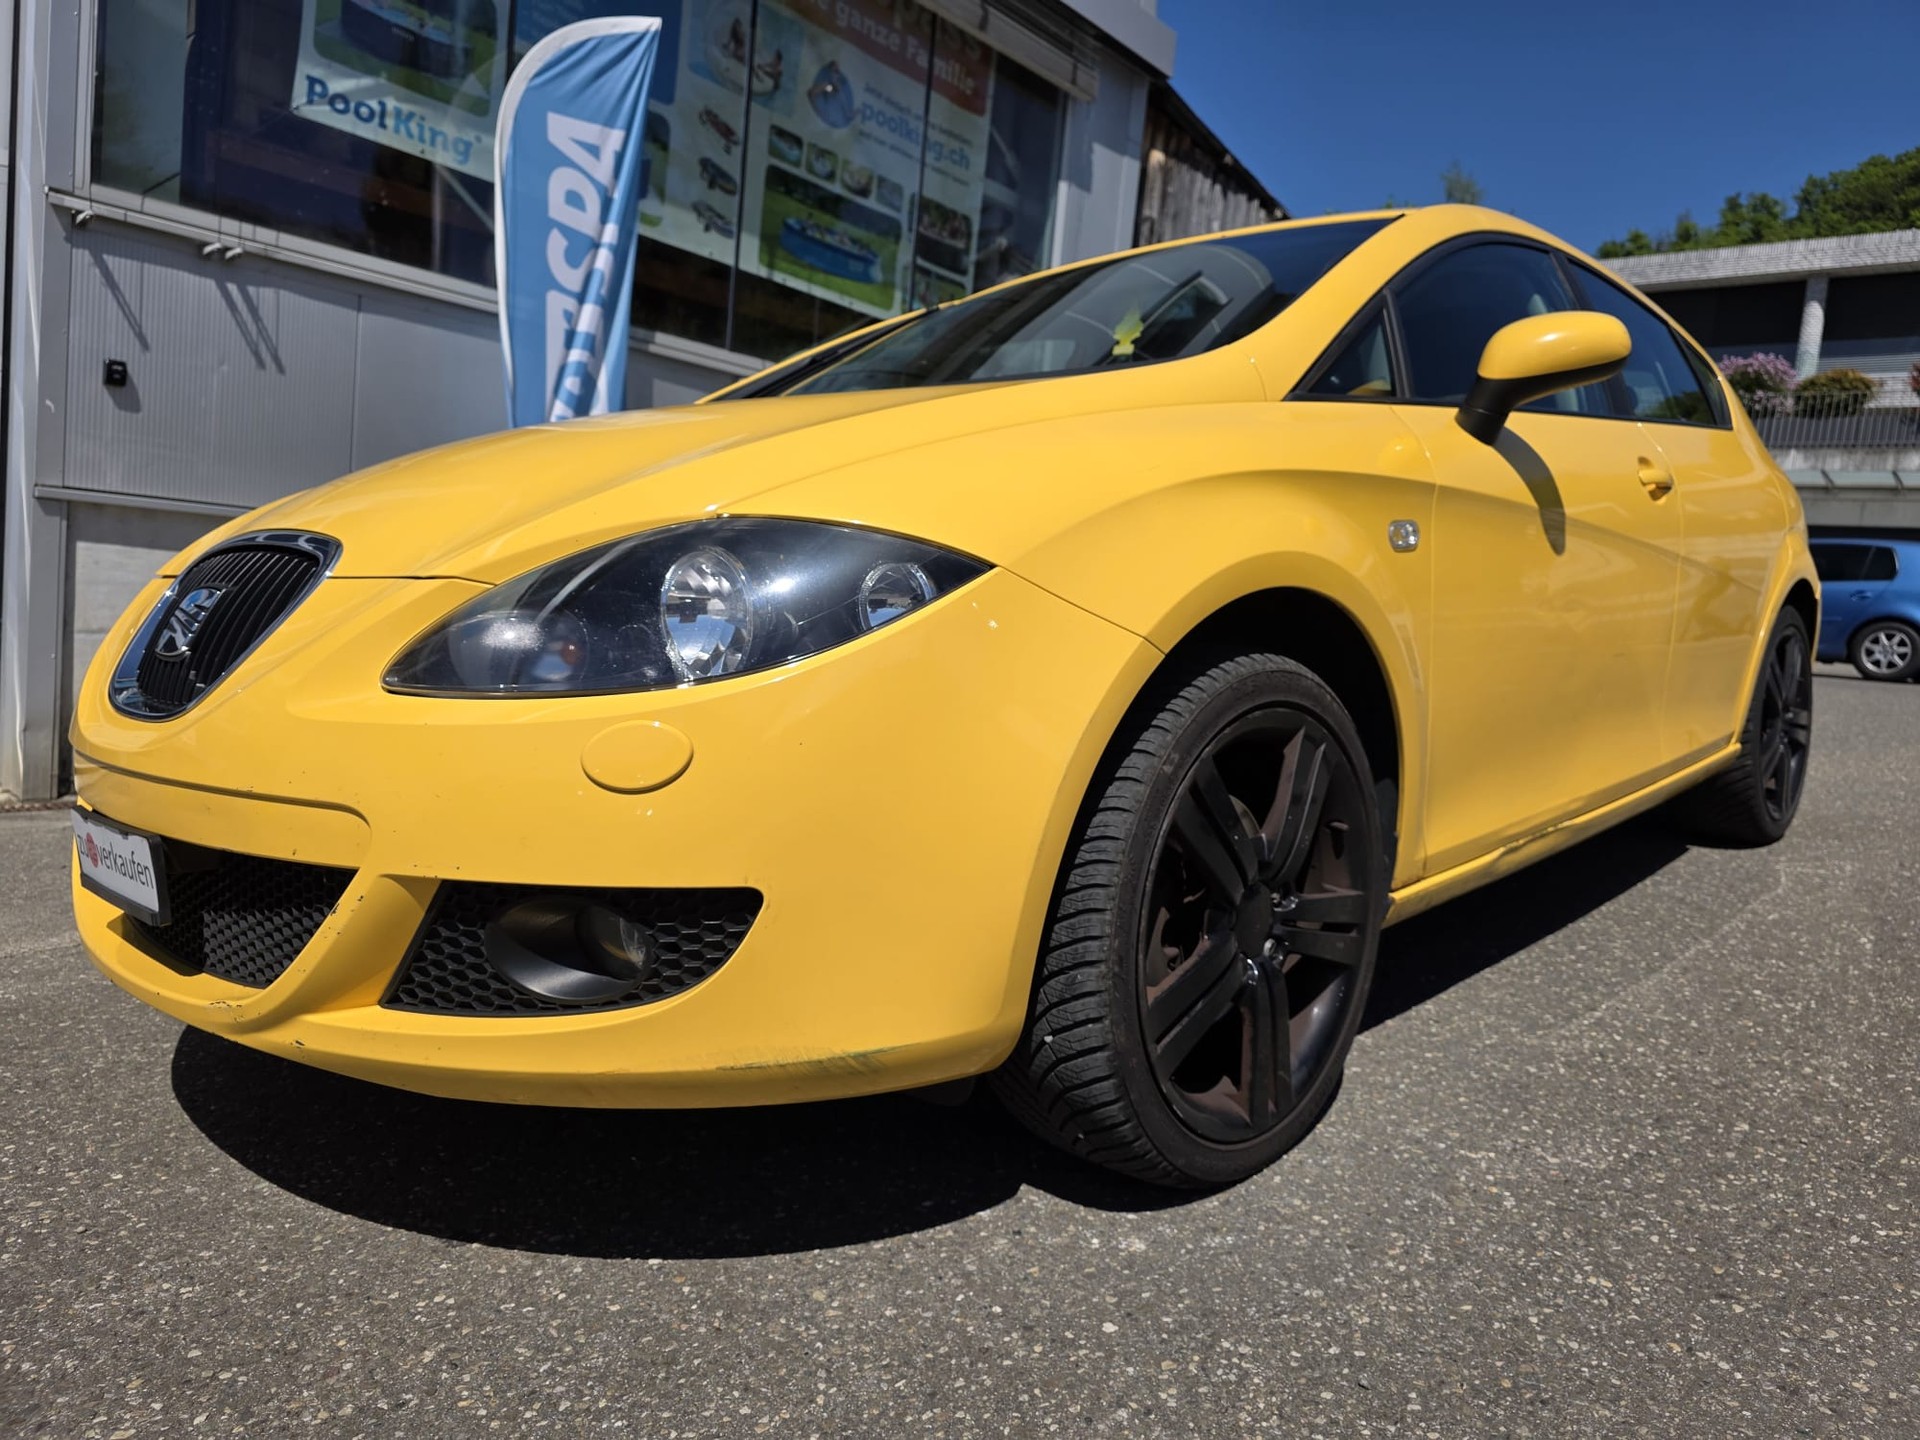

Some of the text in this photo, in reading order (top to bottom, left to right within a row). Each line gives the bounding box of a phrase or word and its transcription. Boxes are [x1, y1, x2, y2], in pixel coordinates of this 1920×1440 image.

[836, 2, 976, 95] ganze Familie
[305, 73, 475, 166] PoolKing
[95, 841, 154, 890] verkaufen
